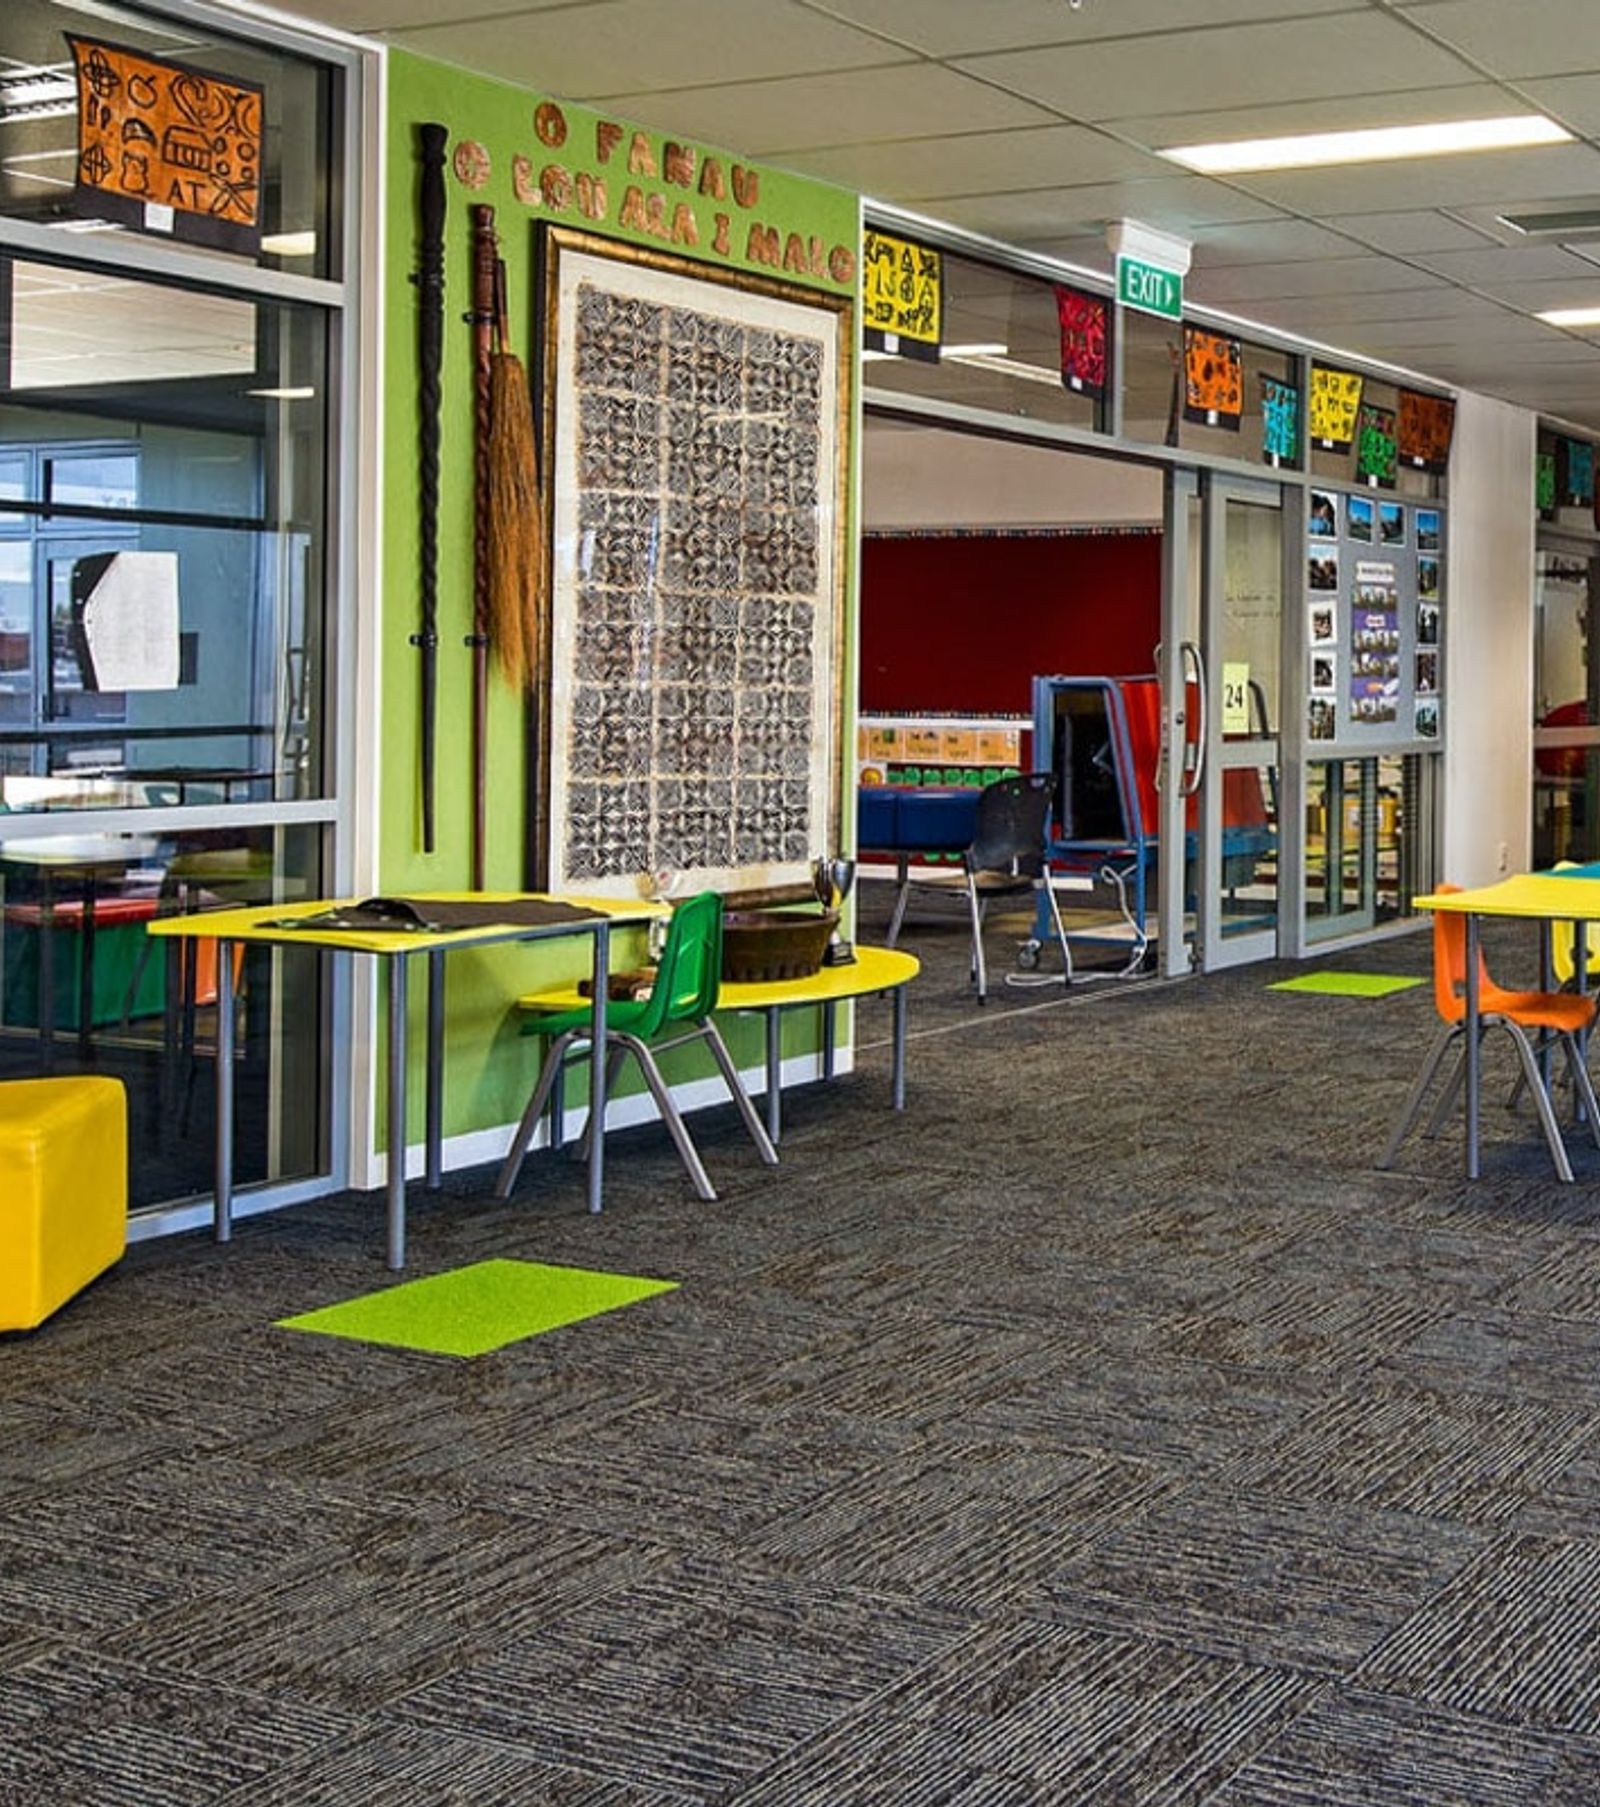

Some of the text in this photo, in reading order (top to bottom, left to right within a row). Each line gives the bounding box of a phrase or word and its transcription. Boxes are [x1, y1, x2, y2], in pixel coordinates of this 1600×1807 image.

[535, 102, 760, 208] O FANAU
[453, 140, 491, 191] O
[714, 212, 731, 256] I
[746, 222, 856, 284] MALO
[1127, 264, 1164, 307] EXIT
[1225, 683, 1243, 709] 24
